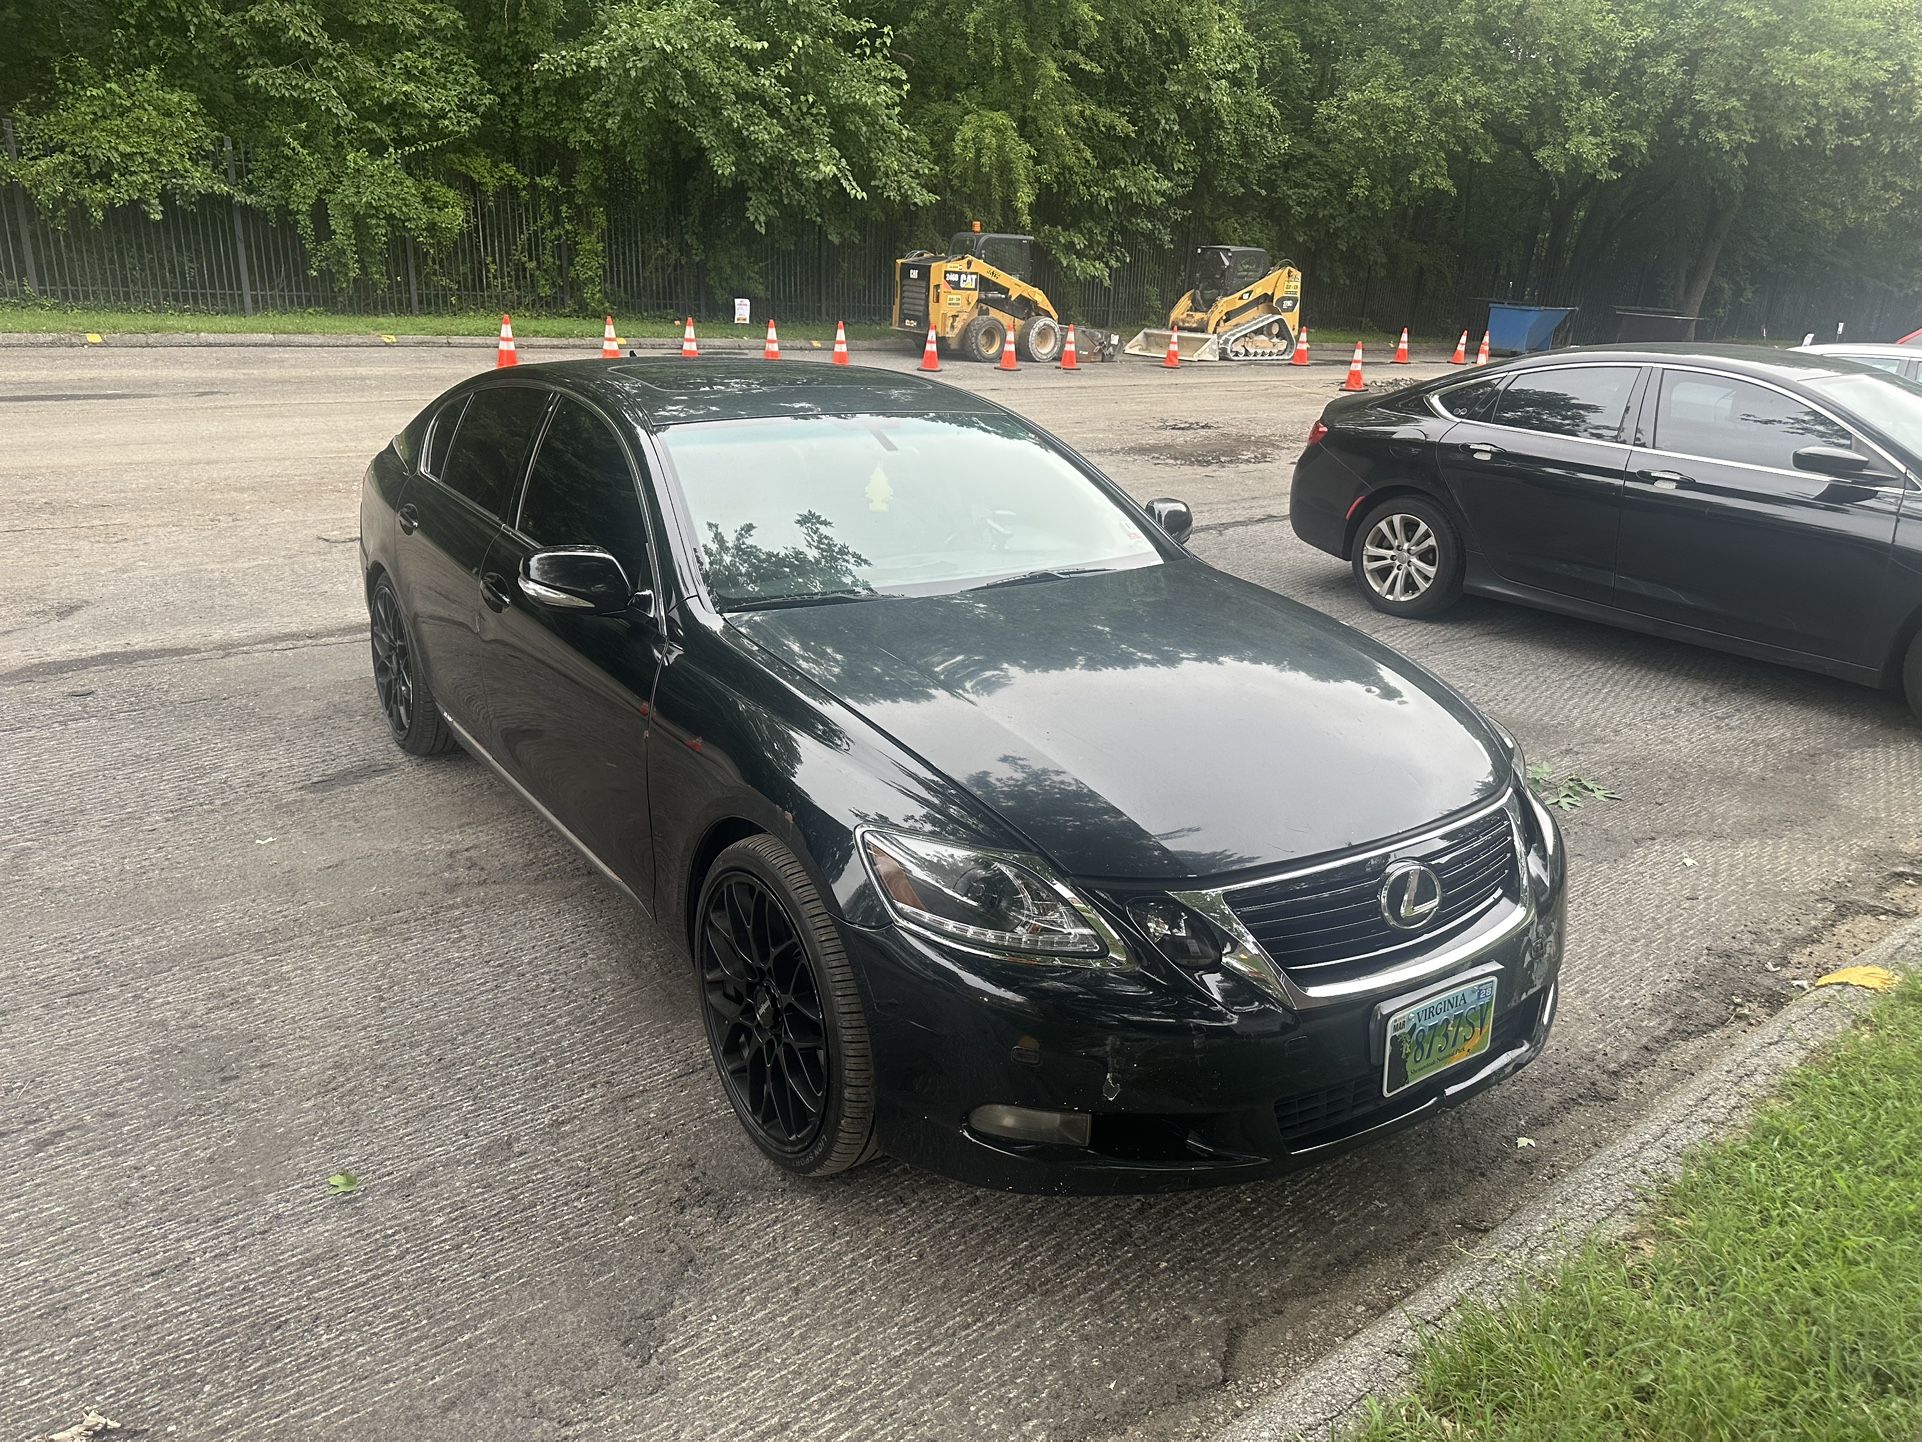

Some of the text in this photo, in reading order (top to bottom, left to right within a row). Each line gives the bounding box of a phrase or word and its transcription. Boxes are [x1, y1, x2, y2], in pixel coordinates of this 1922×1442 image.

[960, 273, 977, 289] CAT
[1480, 987, 1492, 998] 28
[1417, 992, 1467, 1023] VIRGINIA
[1393, 1020, 1406, 1034] MAR
[1413, 1000, 1490, 1063] 8737SV
